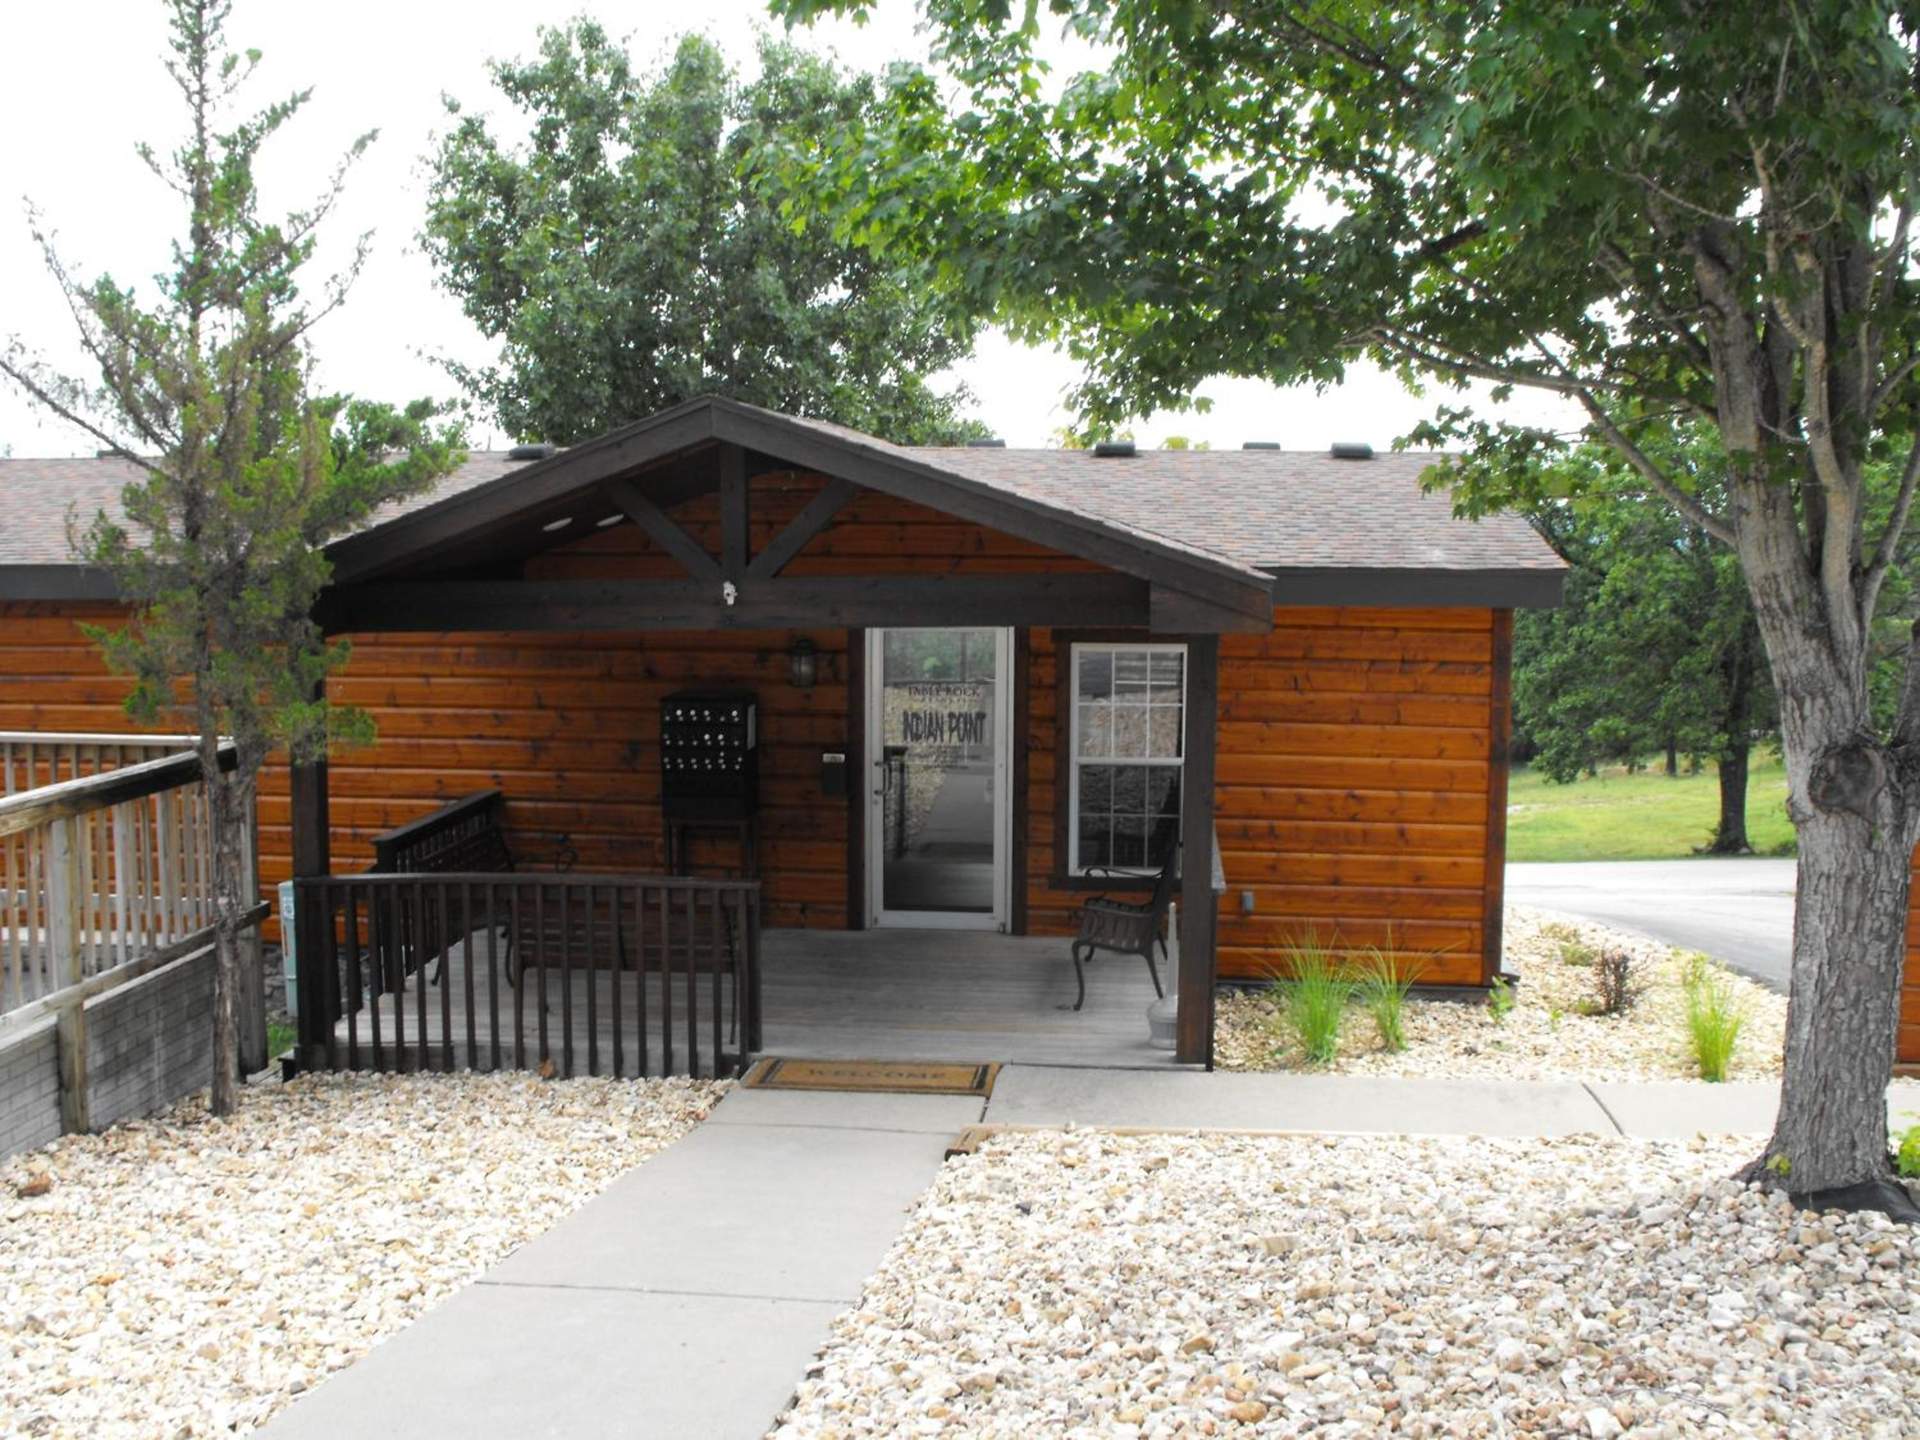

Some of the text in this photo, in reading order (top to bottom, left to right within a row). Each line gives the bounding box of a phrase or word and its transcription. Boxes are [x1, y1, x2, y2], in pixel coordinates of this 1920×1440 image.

[902, 709, 987, 744] INDIAN POINT
[808, 1068, 947, 1080] WELCOME
